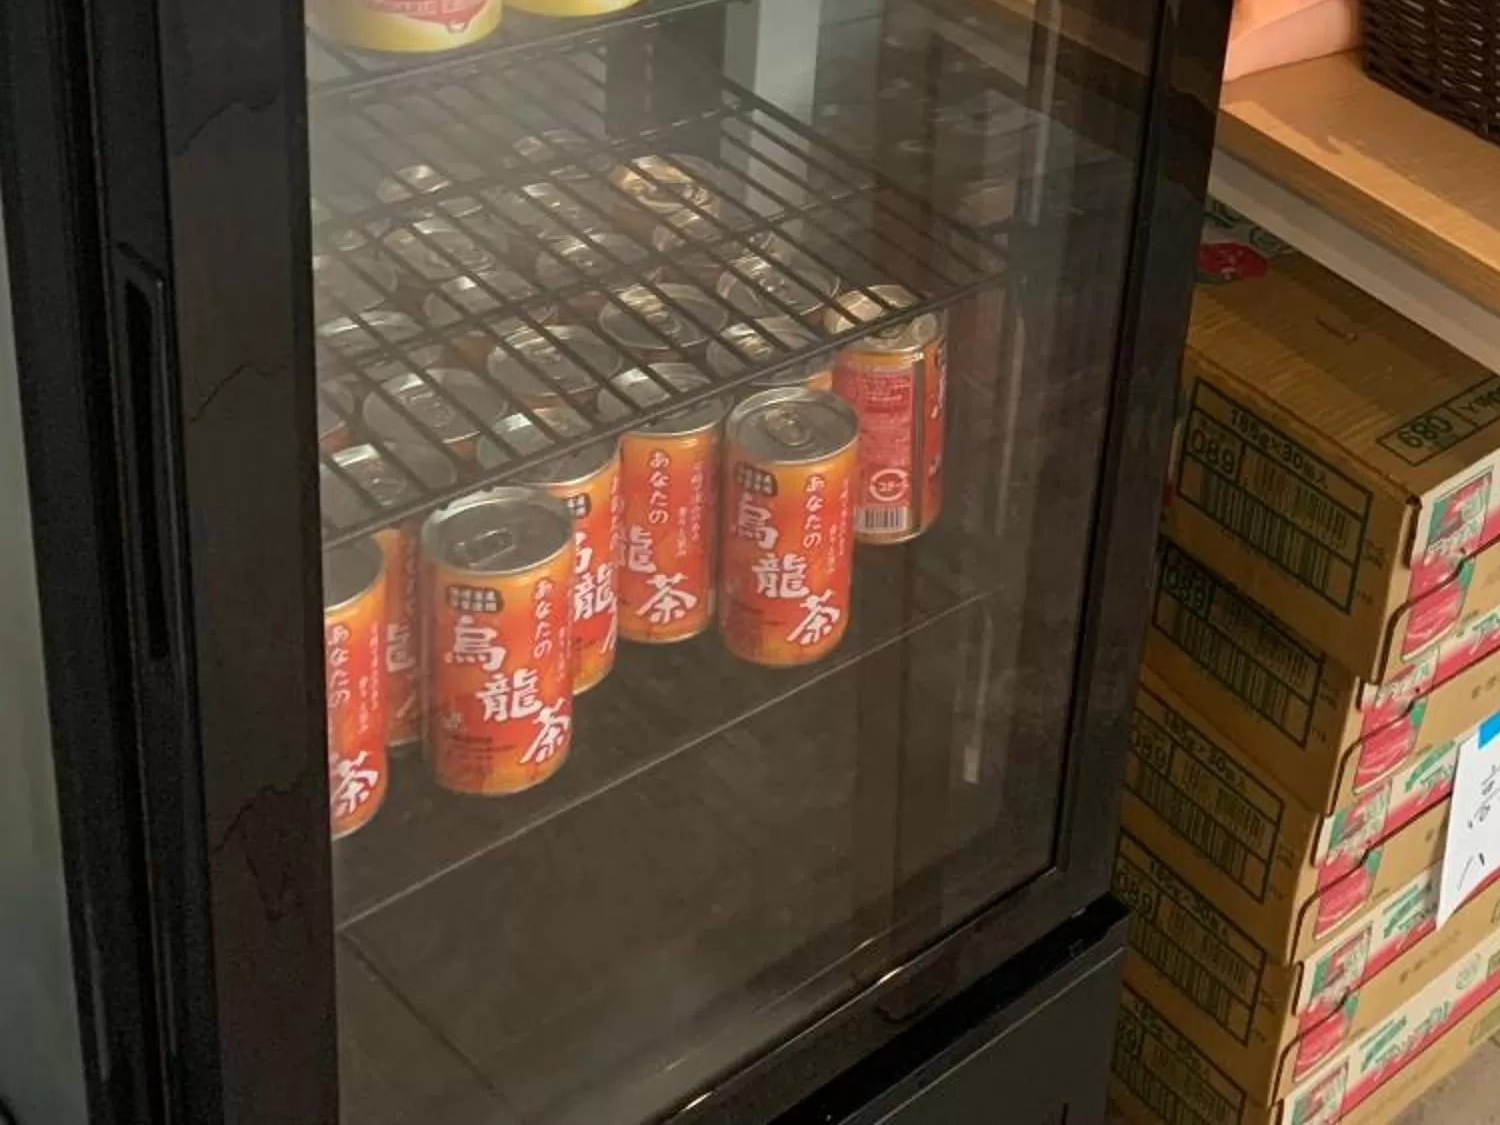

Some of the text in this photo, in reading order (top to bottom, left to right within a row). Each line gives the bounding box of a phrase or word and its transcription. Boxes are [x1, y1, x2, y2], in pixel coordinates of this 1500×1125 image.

[649, 450, 670, 524] あなたの
[803, 475, 825, 549] あなたの
[532, 578, 554, 661] あなたの
[443, 614, 573, 765] 烏龍茶
